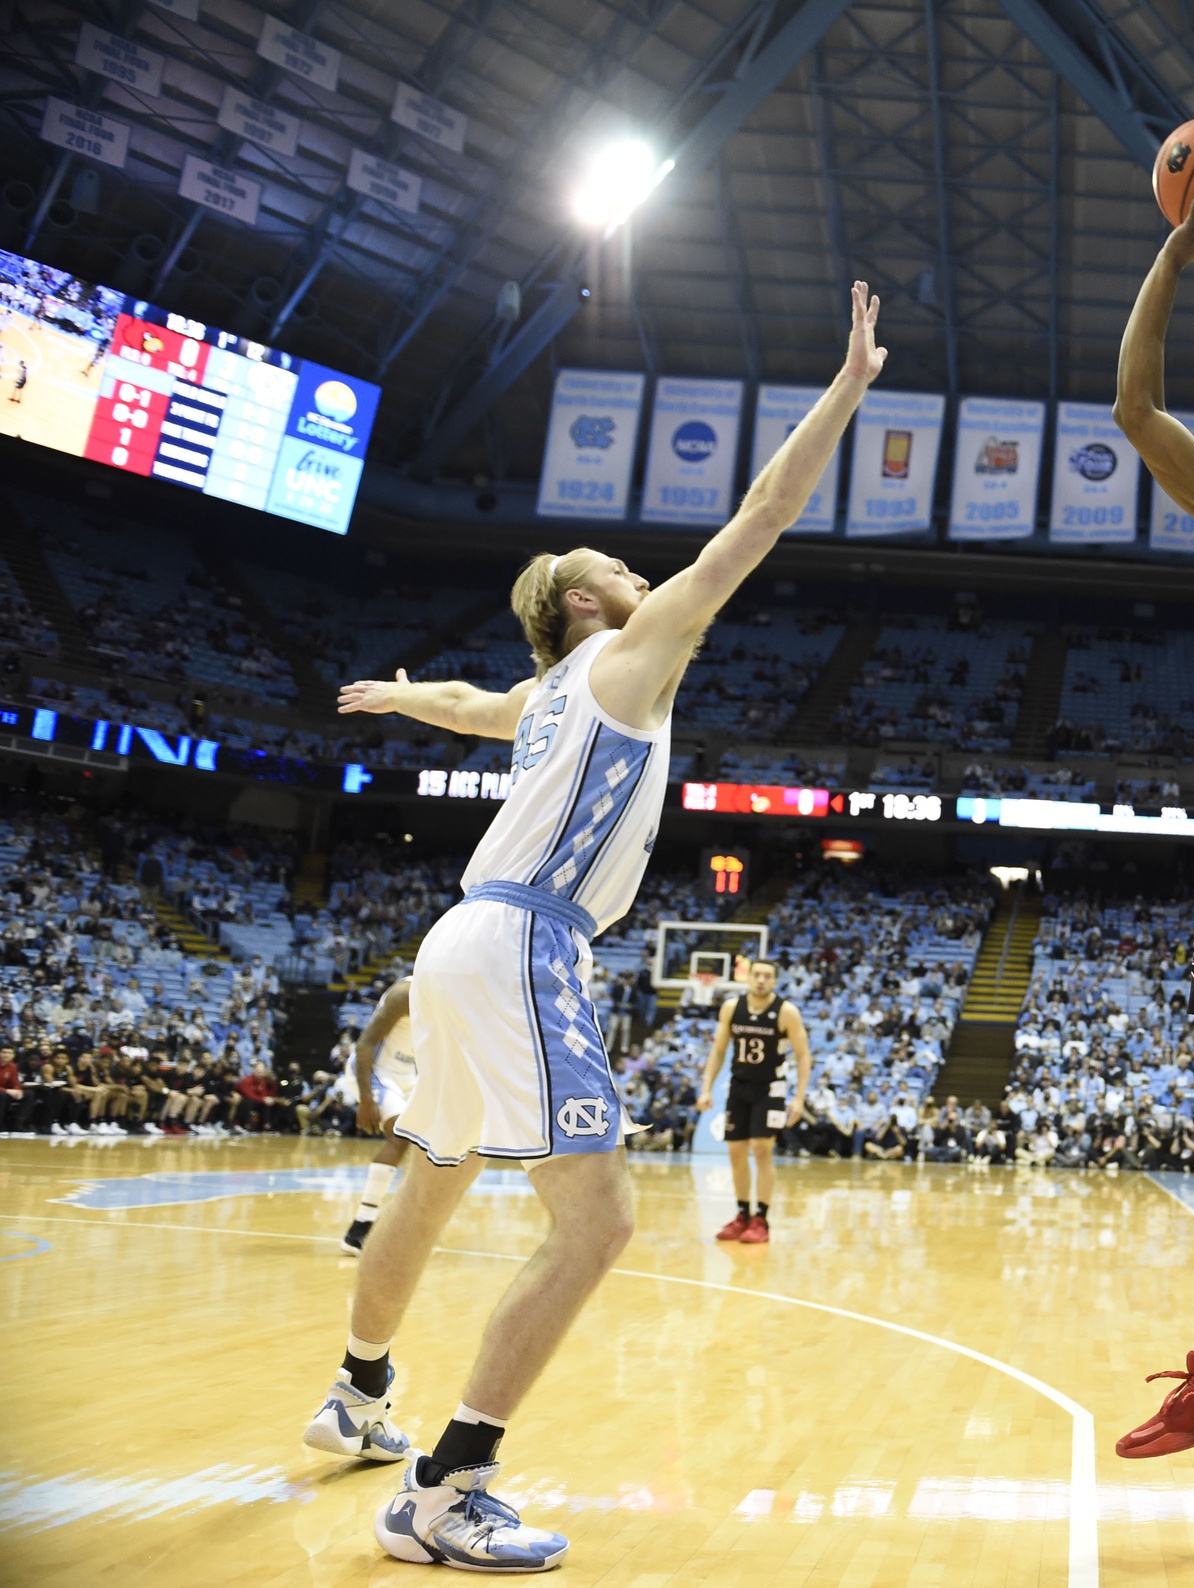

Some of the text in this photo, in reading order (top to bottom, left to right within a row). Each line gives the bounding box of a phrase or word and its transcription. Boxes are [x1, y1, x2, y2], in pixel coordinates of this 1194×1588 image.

[65, 132, 102, 156] 2016
[179, 338, 201, 368] 0
[297, 416, 360, 451] Lottery
[296, 450, 341, 478] Give
[285, 468, 342, 502] UNC
[558, 480, 615, 501] 1924
[661, 486, 719, 508] 1957
[966, 500, 1020, 521] 2005
[1062, 505, 1124, 526] 2009
[797, 788, 815, 816] 0
[714, 870, 741, 894] 11
[736, 1037, 766, 1065] 13
